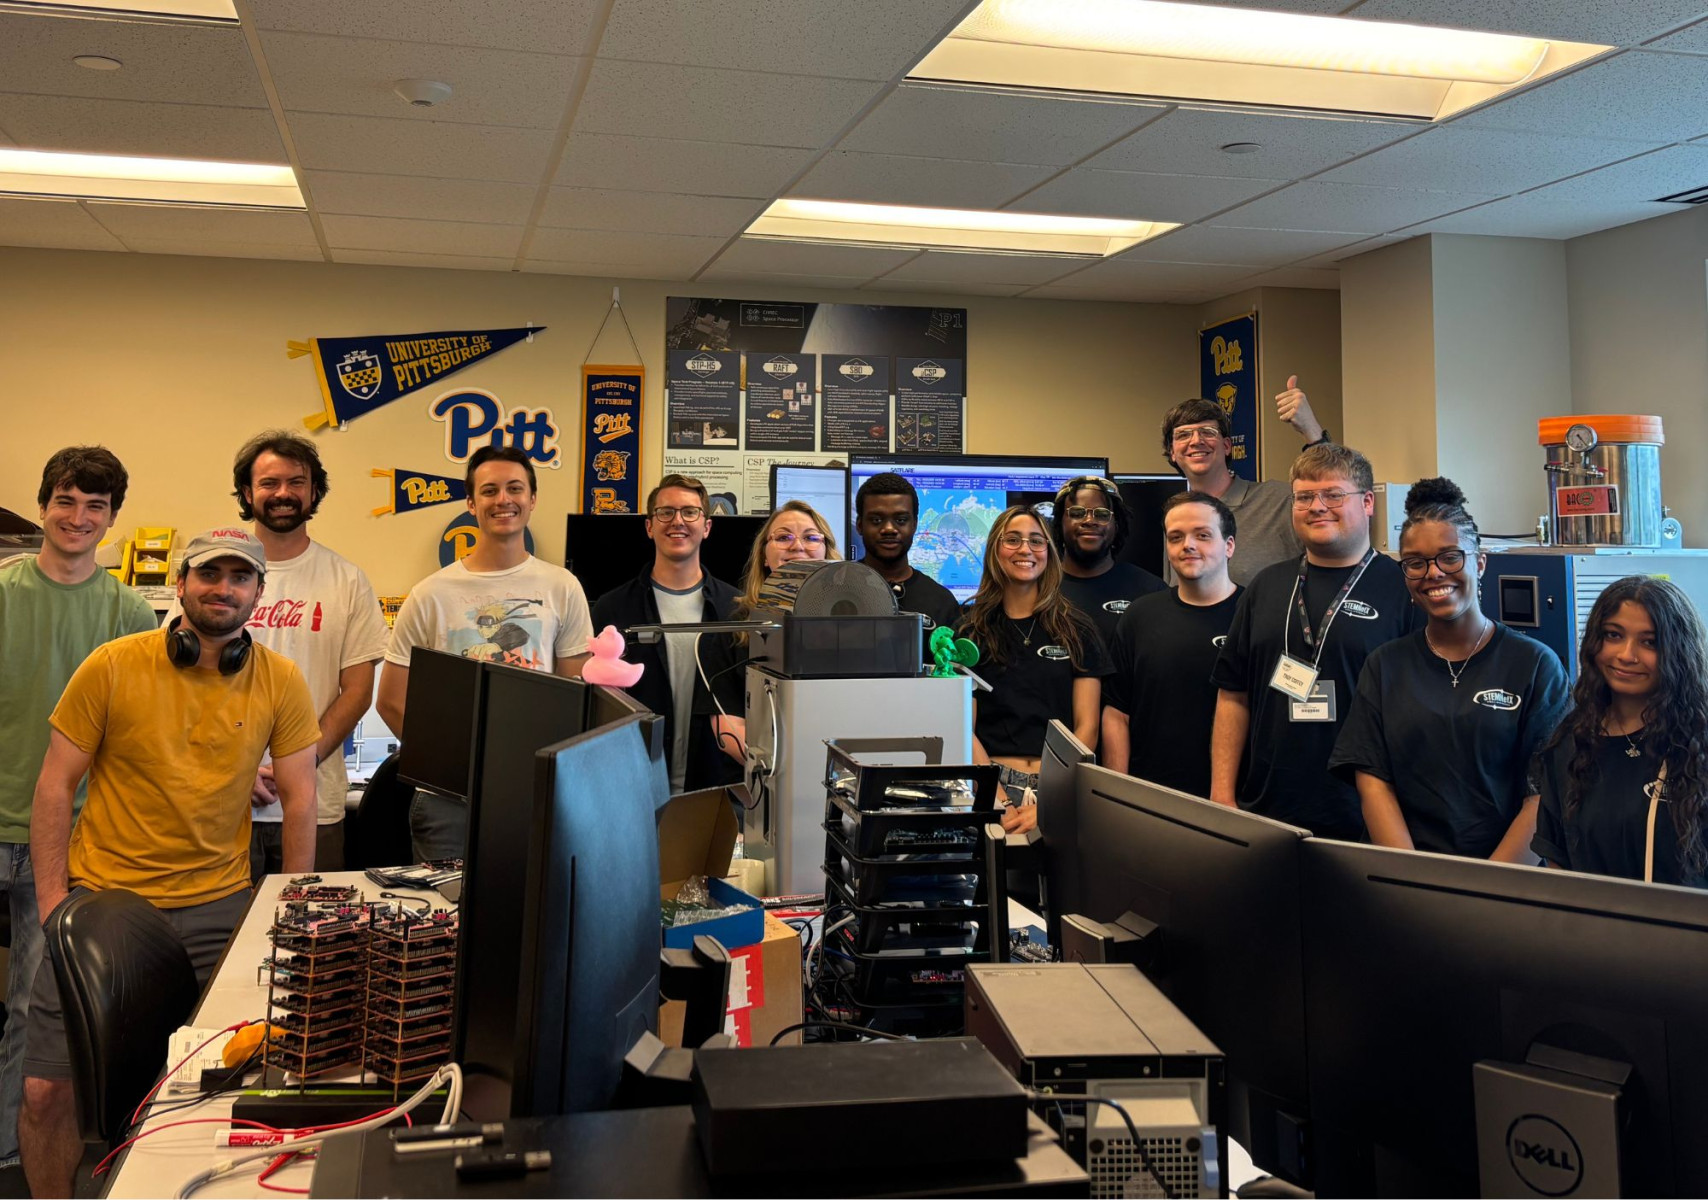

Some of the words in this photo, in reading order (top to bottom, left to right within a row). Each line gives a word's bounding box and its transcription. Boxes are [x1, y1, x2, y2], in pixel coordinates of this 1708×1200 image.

[385, 336, 468, 363] UNIVERSITY
[471, 334, 488, 344] OF
[1211, 335, 1243, 377] Pitt
[392, 342, 492, 391] PITTSBURGH
[773, 364, 789, 372] RAFT
[591, 381, 627, 391] UNIVERSITY
[594, 397, 632, 406] PITTSBURGH
[432, 389, 557, 464] Pitt
[593, 412, 632, 434] Pitt
[665, 456, 687, 464] What
[689, 456, 696, 464] is
[698, 456, 720, 465] CSP?
[747, 458, 764, 466] CSP
[401, 477, 452, 505] Pitt
[212, 530, 250, 542] NASA
[1513, 1137, 1576, 1172] DELL
